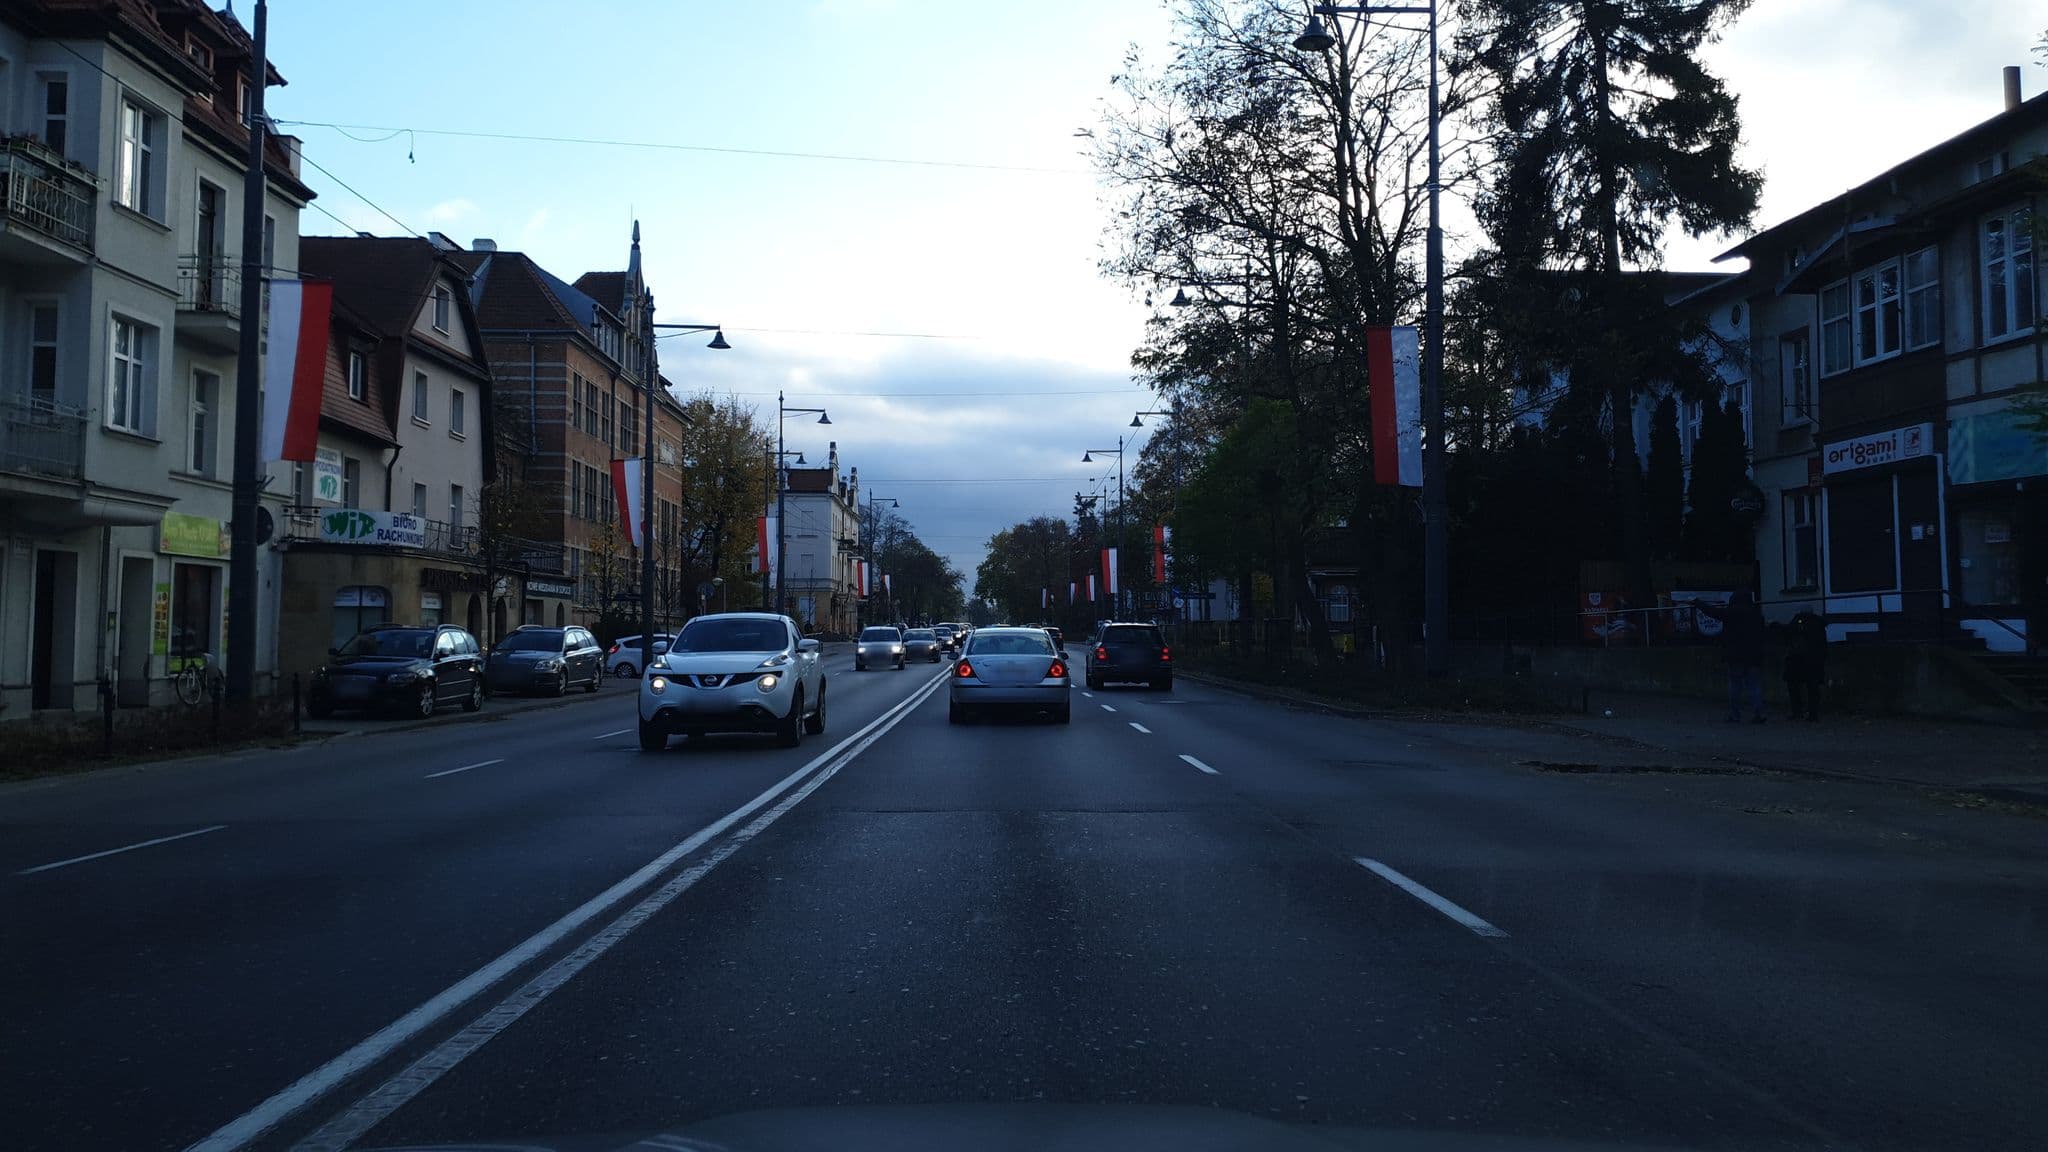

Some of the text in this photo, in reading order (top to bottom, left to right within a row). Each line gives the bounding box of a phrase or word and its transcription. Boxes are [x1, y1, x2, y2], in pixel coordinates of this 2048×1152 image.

[1829, 433, 1896, 465] origami
[393, 516, 417, 530] BIURO
[377, 528, 423, 546] RACHUNKOWE
